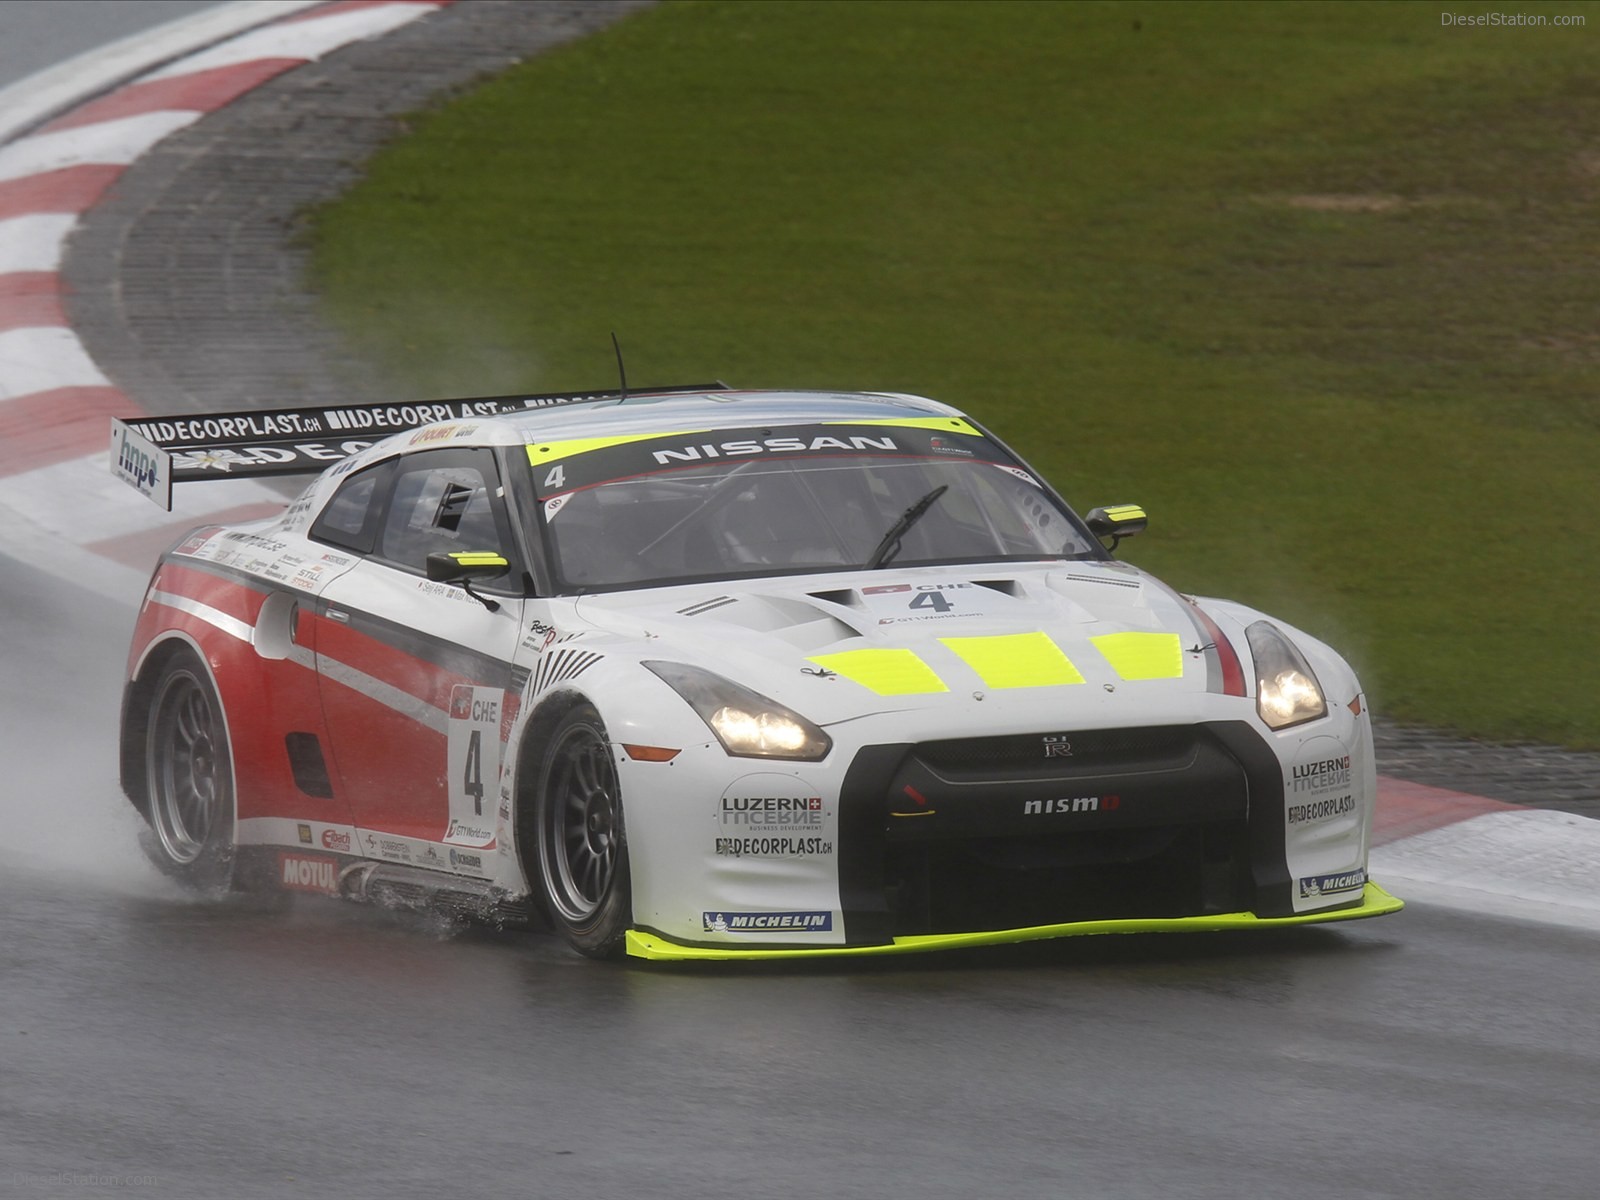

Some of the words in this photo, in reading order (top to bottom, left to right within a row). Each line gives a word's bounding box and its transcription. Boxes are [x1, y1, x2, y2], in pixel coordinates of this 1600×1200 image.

[652, 436, 898, 465] NISSAN
[544, 464, 566, 488] 4
[916, 583, 973, 591] CHE
[908, 591, 954, 613] 4
[472, 700, 497, 723] CHE
[464, 730, 484, 817] 4
[1293, 757, 1344, 779] LUZERN
[723, 798, 808, 811] LUZERN
[284, 858, 337, 889] MOTUL
[731, 915, 826, 927] MICHELIN
